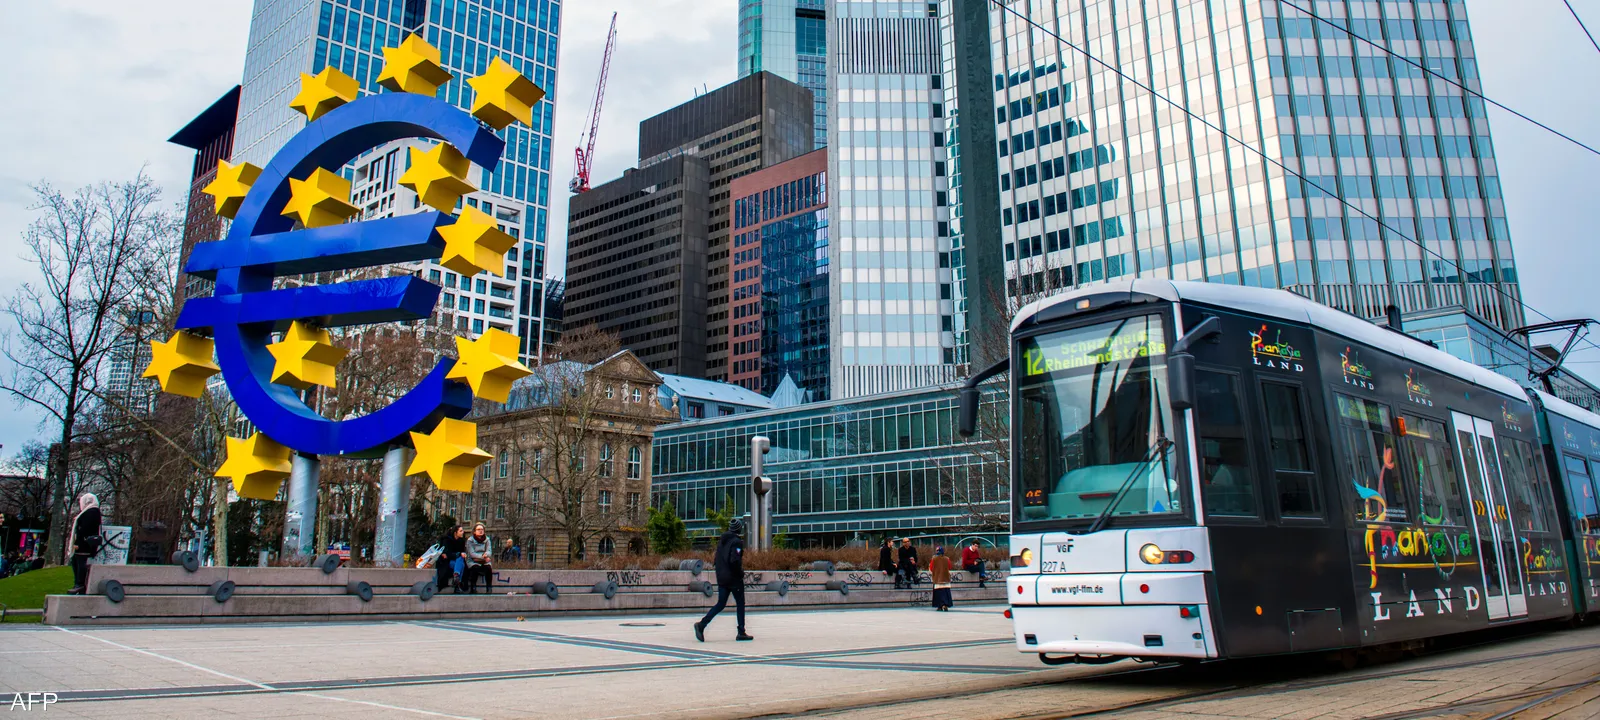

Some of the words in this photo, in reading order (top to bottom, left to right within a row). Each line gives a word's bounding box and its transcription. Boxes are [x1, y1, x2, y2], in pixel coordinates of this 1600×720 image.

[1023, 348, 1044, 376] 12
[1045, 340, 1166, 371] Rheinlandstraße
[1253, 357, 1304, 372] LAND
[1344, 375, 1375, 391] LAND
[1408, 395, 1433, 407] LAND
[1057, 539, 1074, 553] VGF
[1042, 562, 1057, 573] 227
[1060, 562, 1067, 573] A
[1051, 585, 1104, 594] www.vgf-ffm.de
[1528, 581, 1567, 597] LAND
[1370, 586, 1480, 621] LAND
